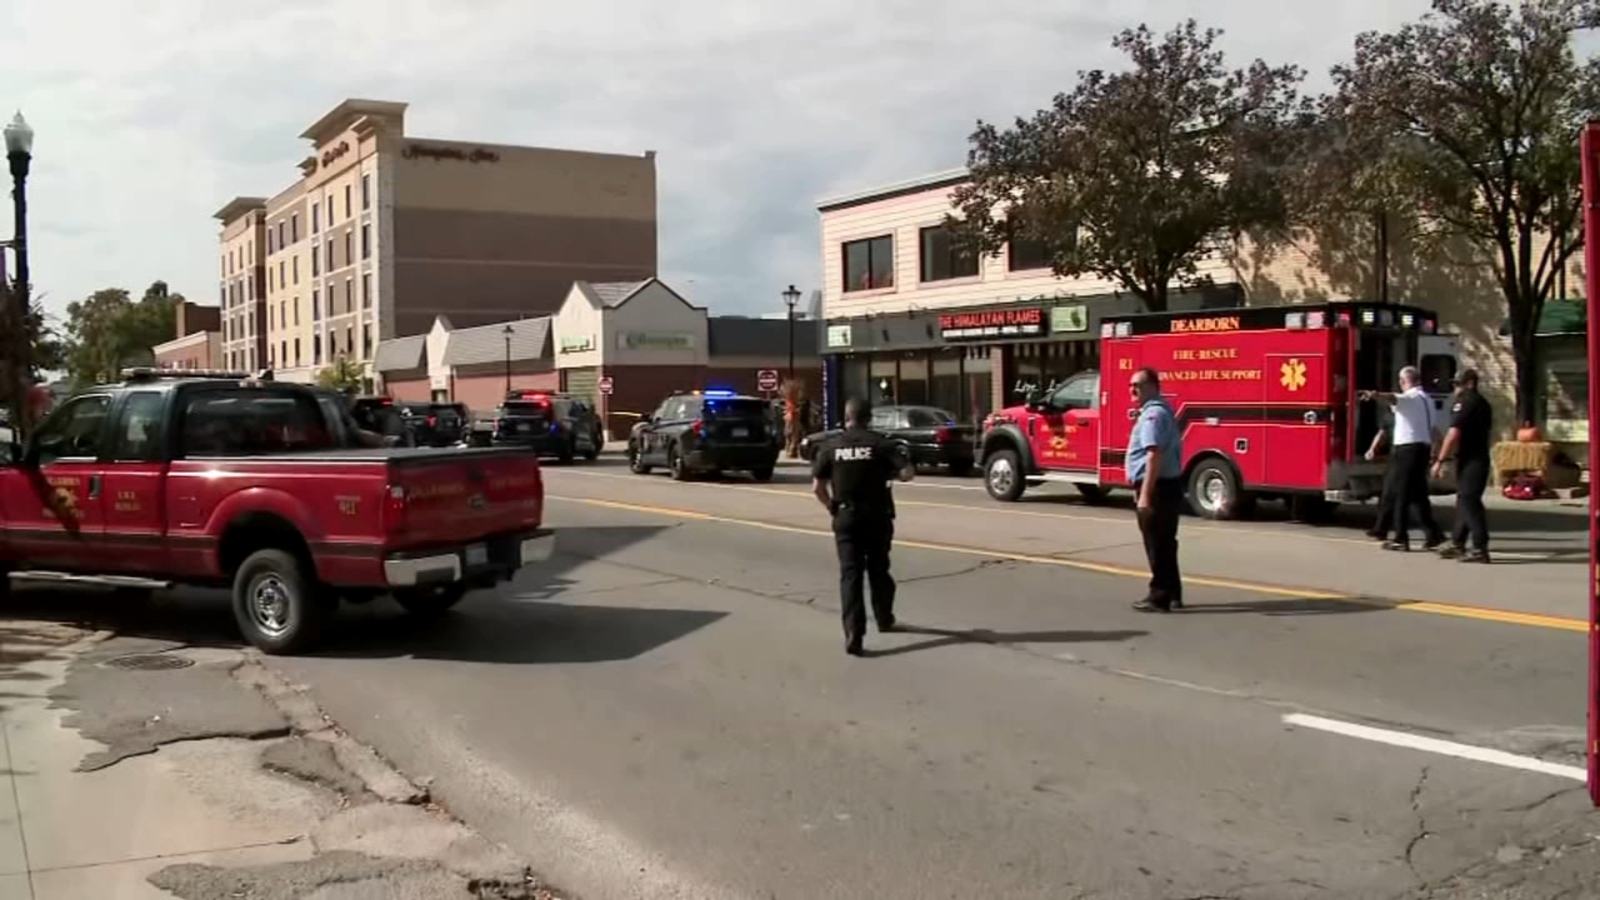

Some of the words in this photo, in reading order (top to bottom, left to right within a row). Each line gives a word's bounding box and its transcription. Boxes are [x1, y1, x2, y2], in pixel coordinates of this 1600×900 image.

[953, 311, 1005, 328] HIMALAYAN
[1006, 308, 1041, 325] FLAMES
[1170, 316, 1240, 333] DEARBORN
[1200, 370, 1220, 381] LIFE
[1221, 369, 1261, 381] SUPPORT
[834, 446, 872, 461] POLICE
